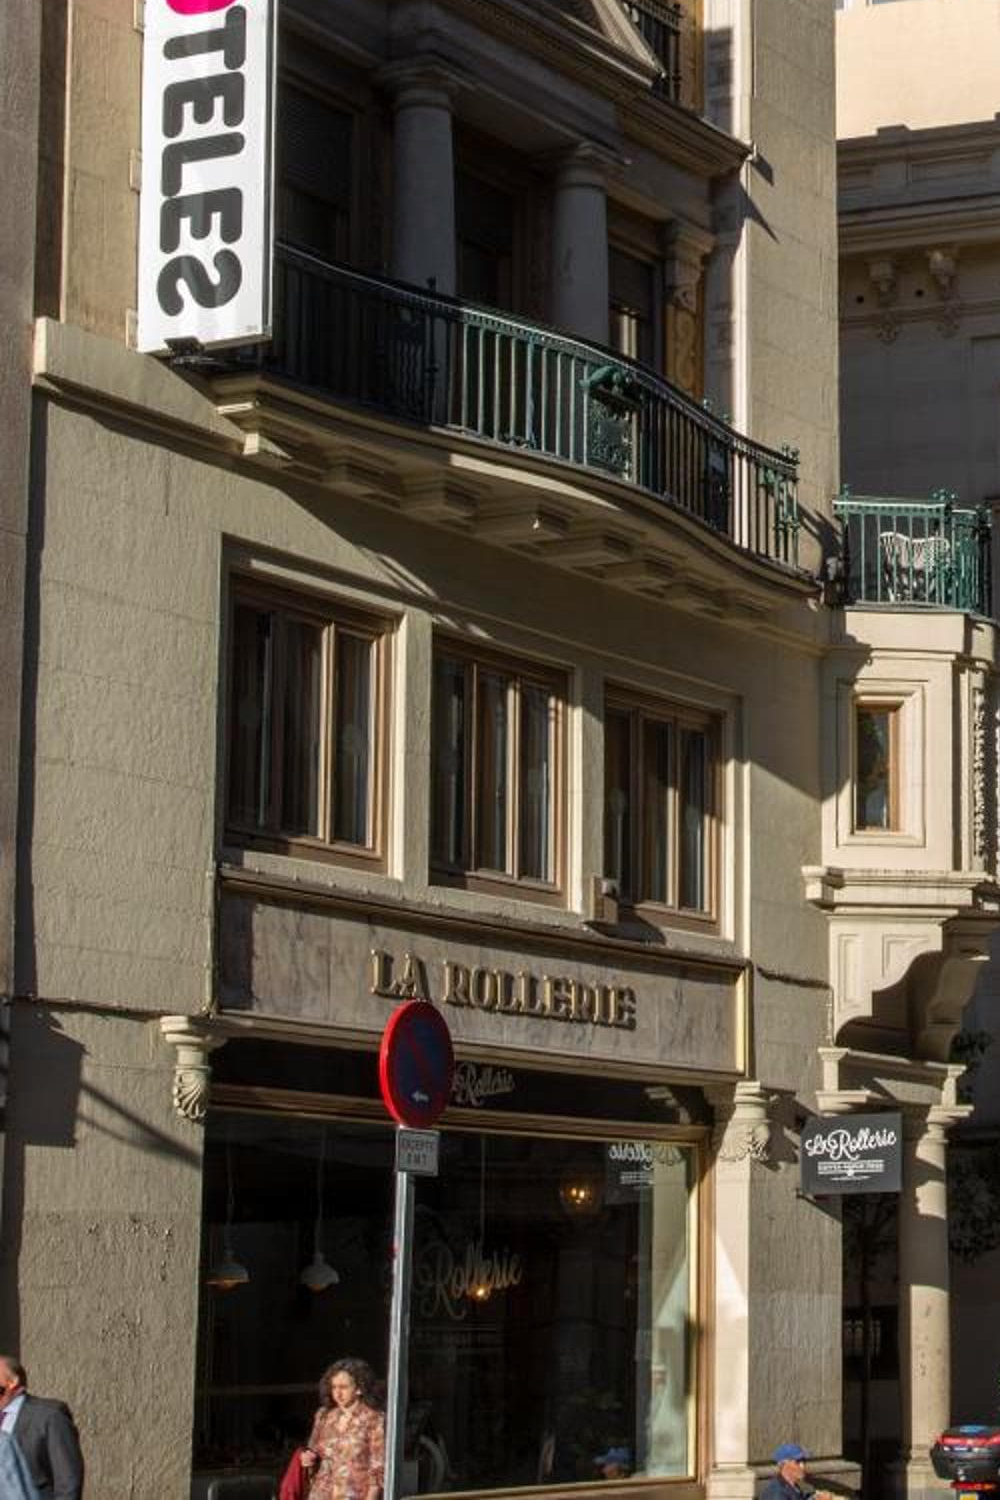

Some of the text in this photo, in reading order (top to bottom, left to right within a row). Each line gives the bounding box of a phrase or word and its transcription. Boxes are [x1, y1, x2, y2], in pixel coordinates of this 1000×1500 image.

[371, 950, 637, 1031] LA ROLLERIE
[827, 1127, 896, 1161] Rollerie
